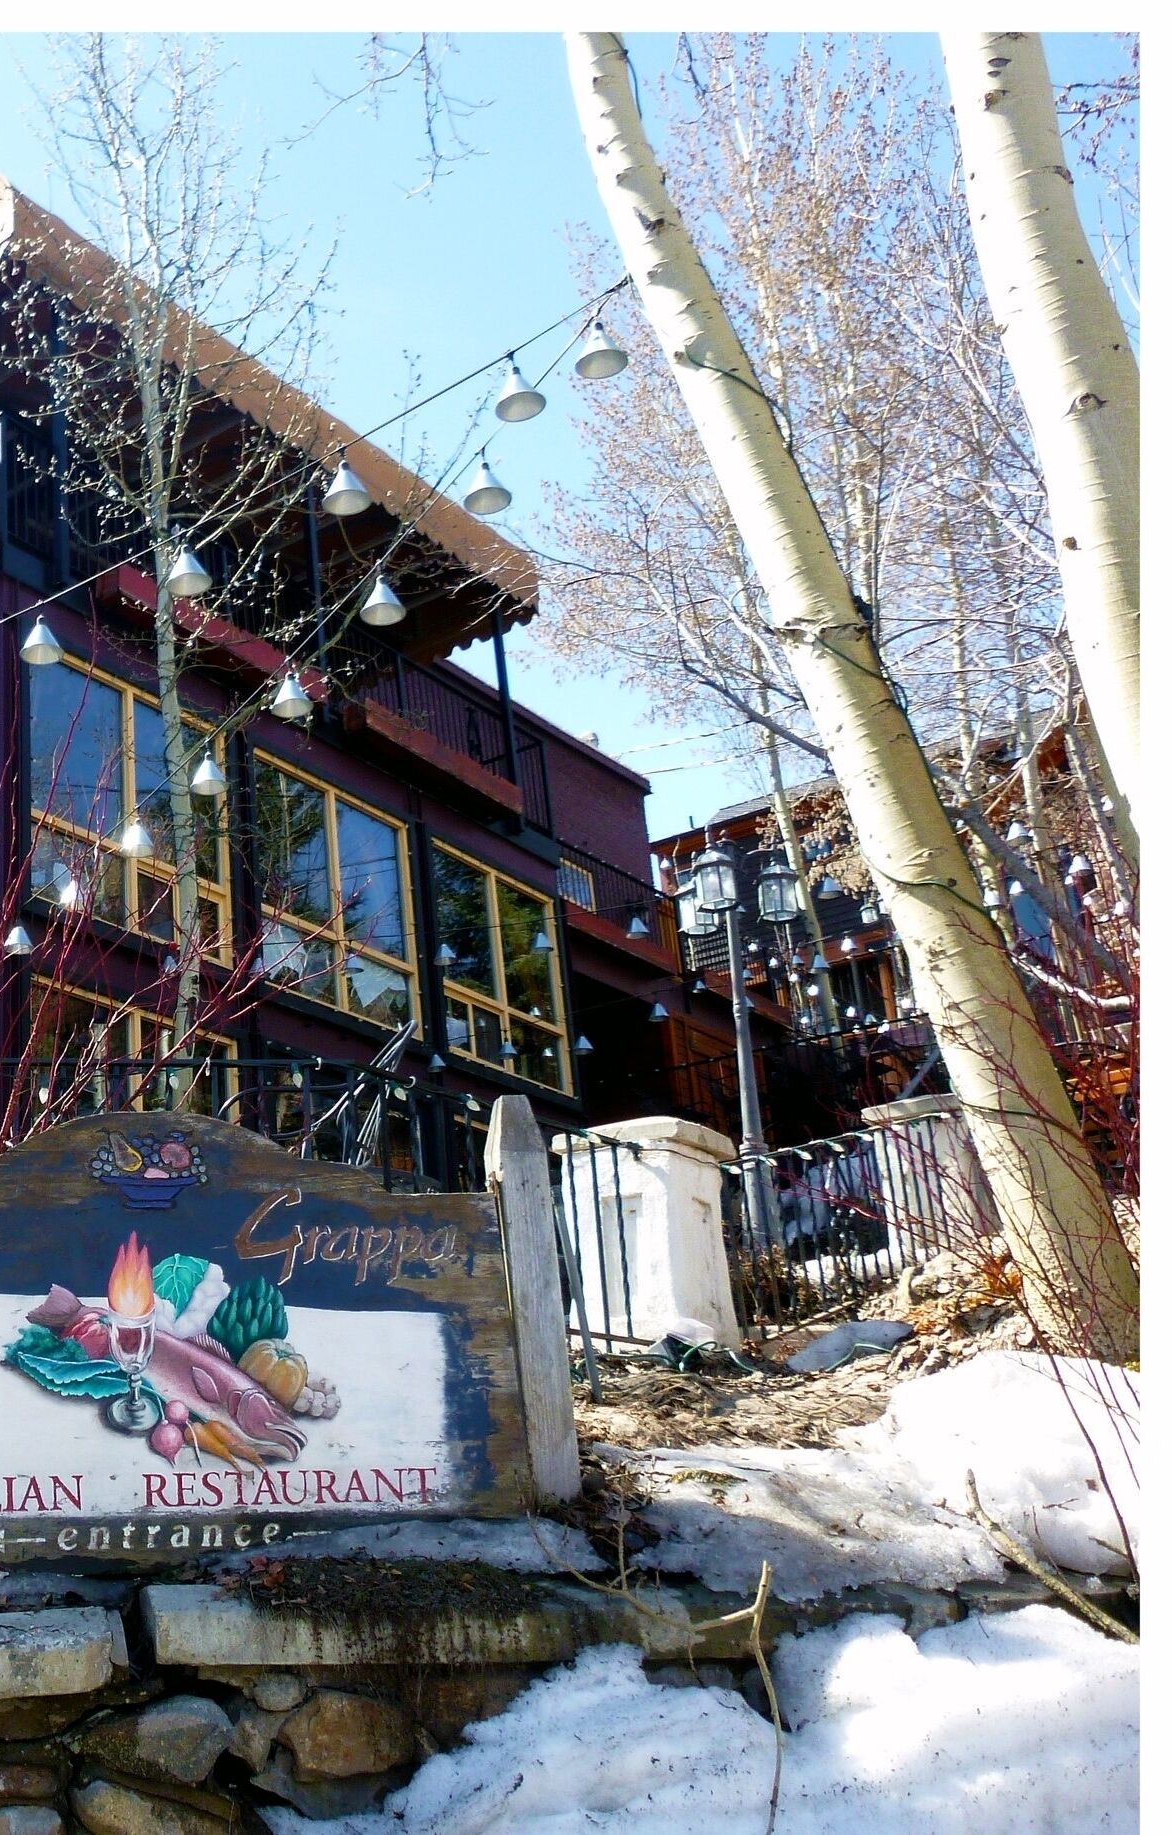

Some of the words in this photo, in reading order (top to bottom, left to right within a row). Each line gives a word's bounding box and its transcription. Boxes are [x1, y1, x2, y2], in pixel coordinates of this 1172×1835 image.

[235, 1187, 459, 1286] Grappa
[142, 1467, 437, 1508] RESTAURANT
[57, 1522, 279, 1551] entrance
